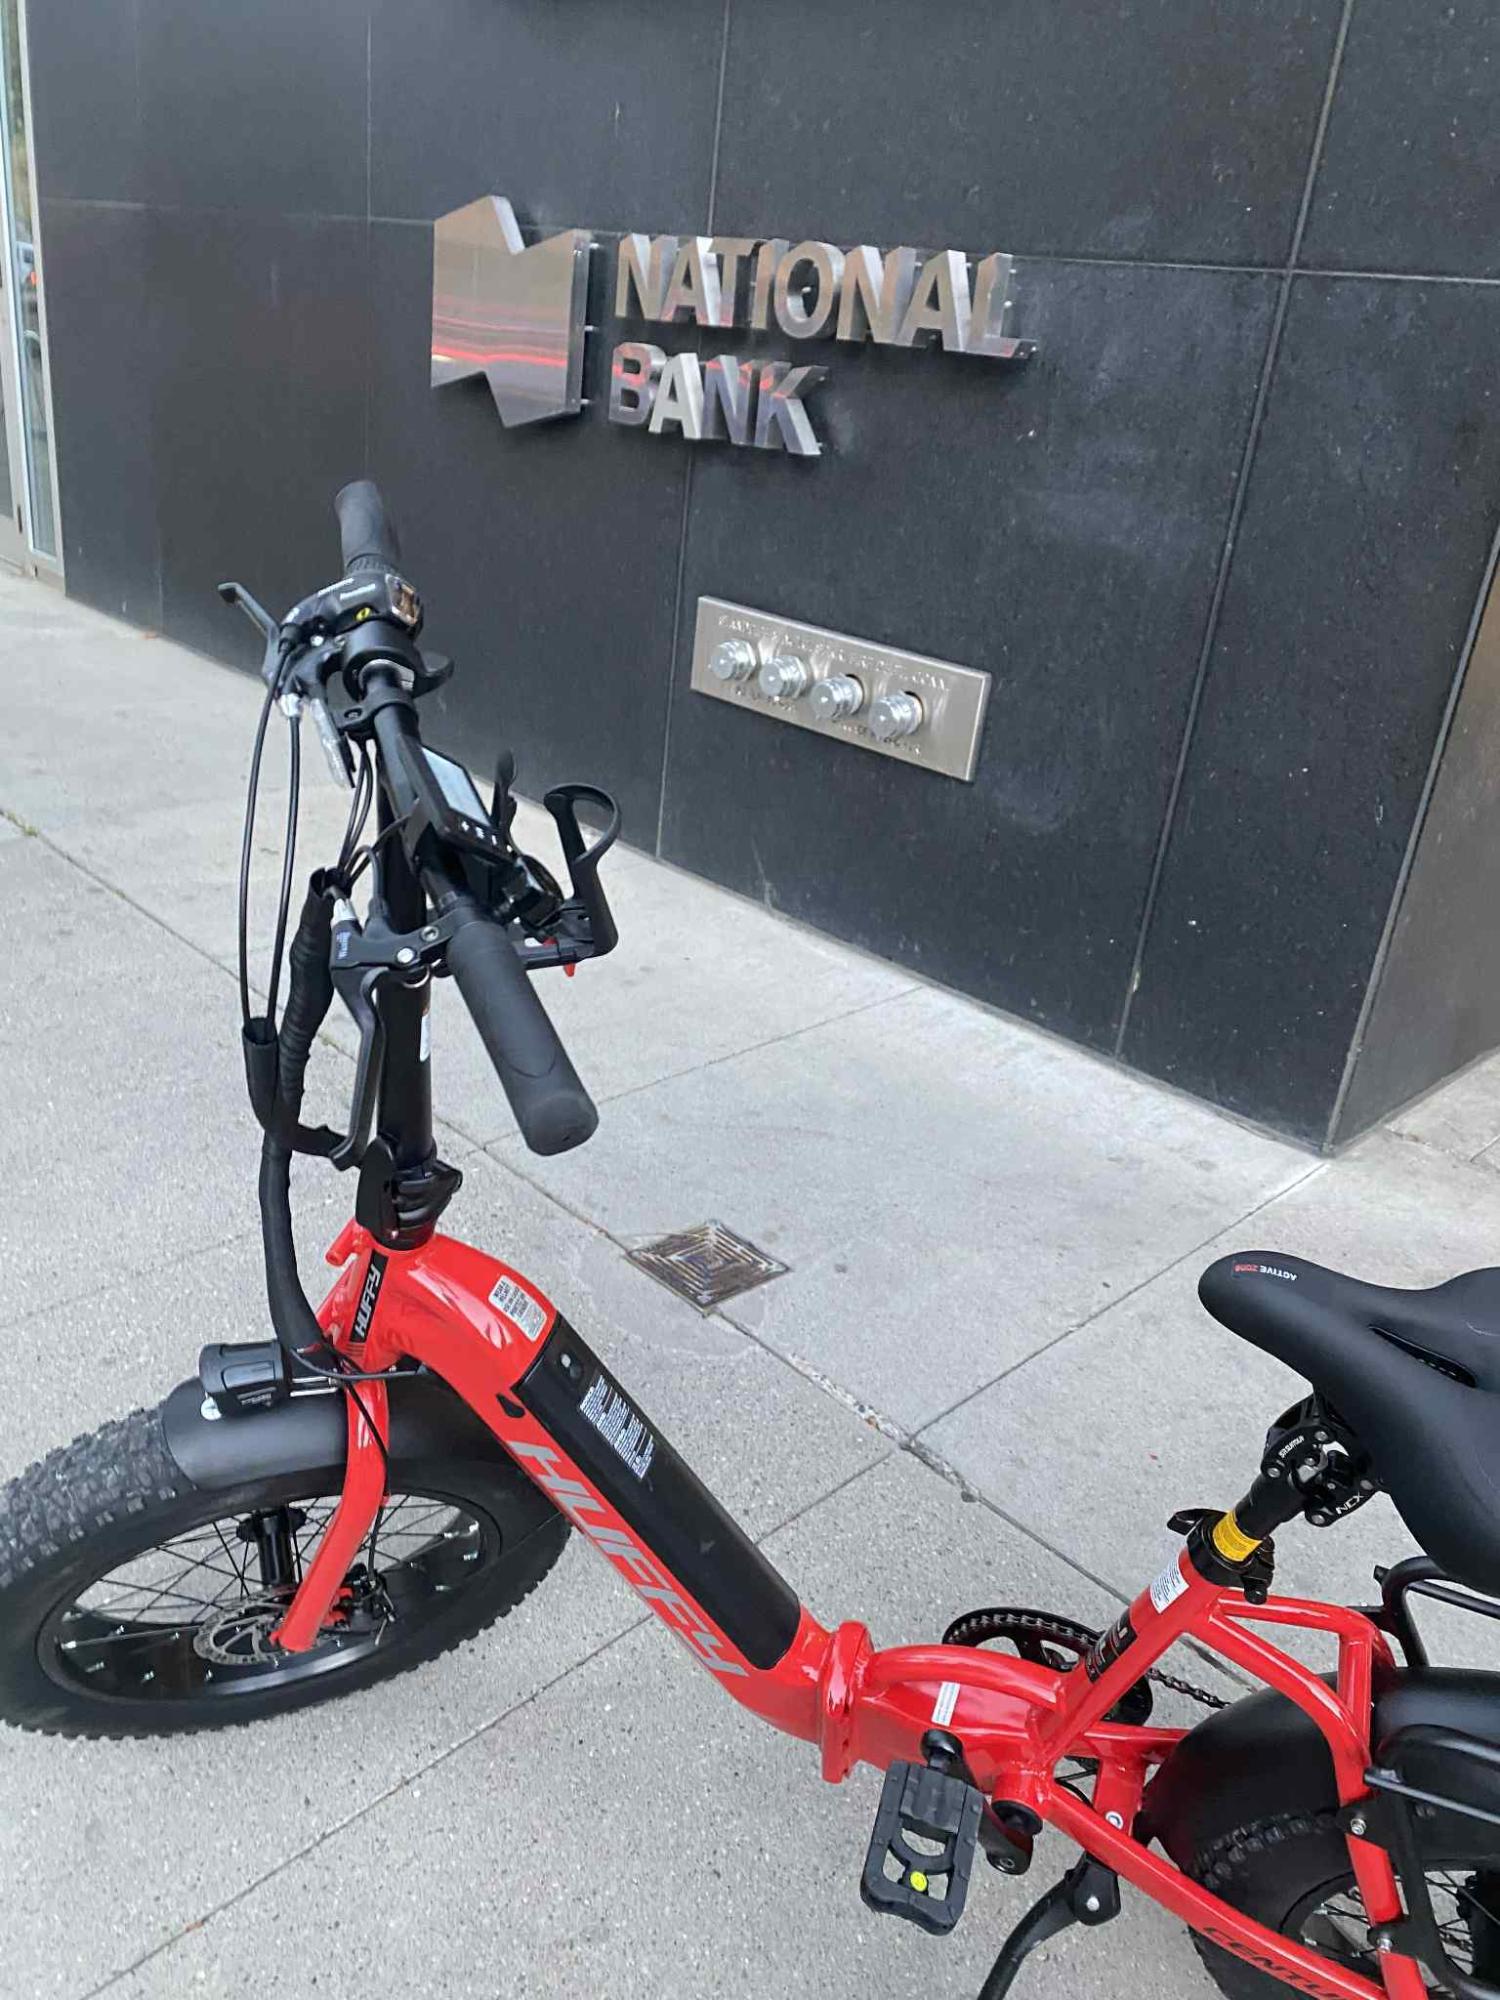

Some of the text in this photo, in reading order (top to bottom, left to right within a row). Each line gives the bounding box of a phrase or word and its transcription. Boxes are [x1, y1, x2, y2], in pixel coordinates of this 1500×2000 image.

[614, 232, 1037, 360] NATIONAL
[608, 341, 828, 456] BANK
[354, 1263, 382, 1338] HUFFY
[1259, 1264, 1298, 1281] ACTIVE
[507, 1440, 750, 1677] HUFFY
